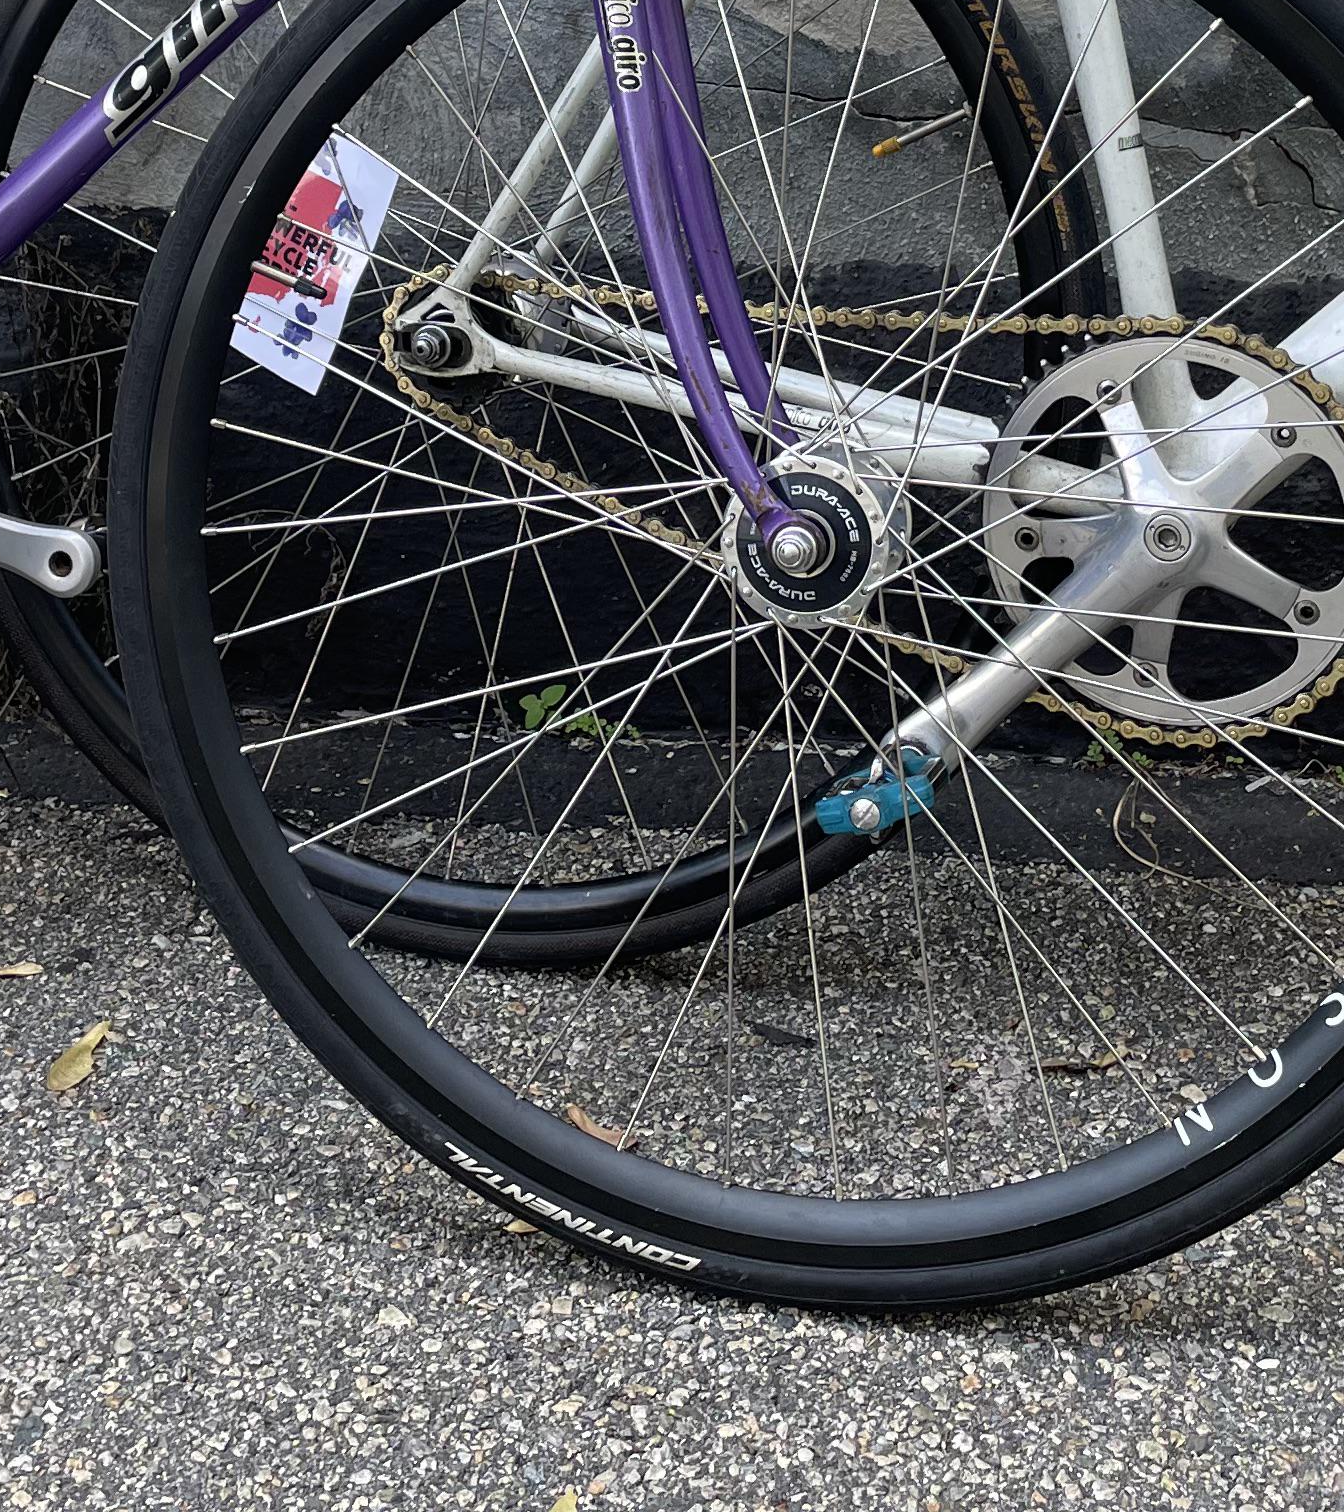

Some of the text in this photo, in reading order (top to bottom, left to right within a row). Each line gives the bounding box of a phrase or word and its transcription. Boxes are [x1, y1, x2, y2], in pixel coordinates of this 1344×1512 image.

[612, 37, 647, 90] giro
[790, 484, 860, 544] DURA-ACE
[747, 542, 817, 602] DURA-ACE
[443, 1141, 704, 1272] CONTINENTAL
